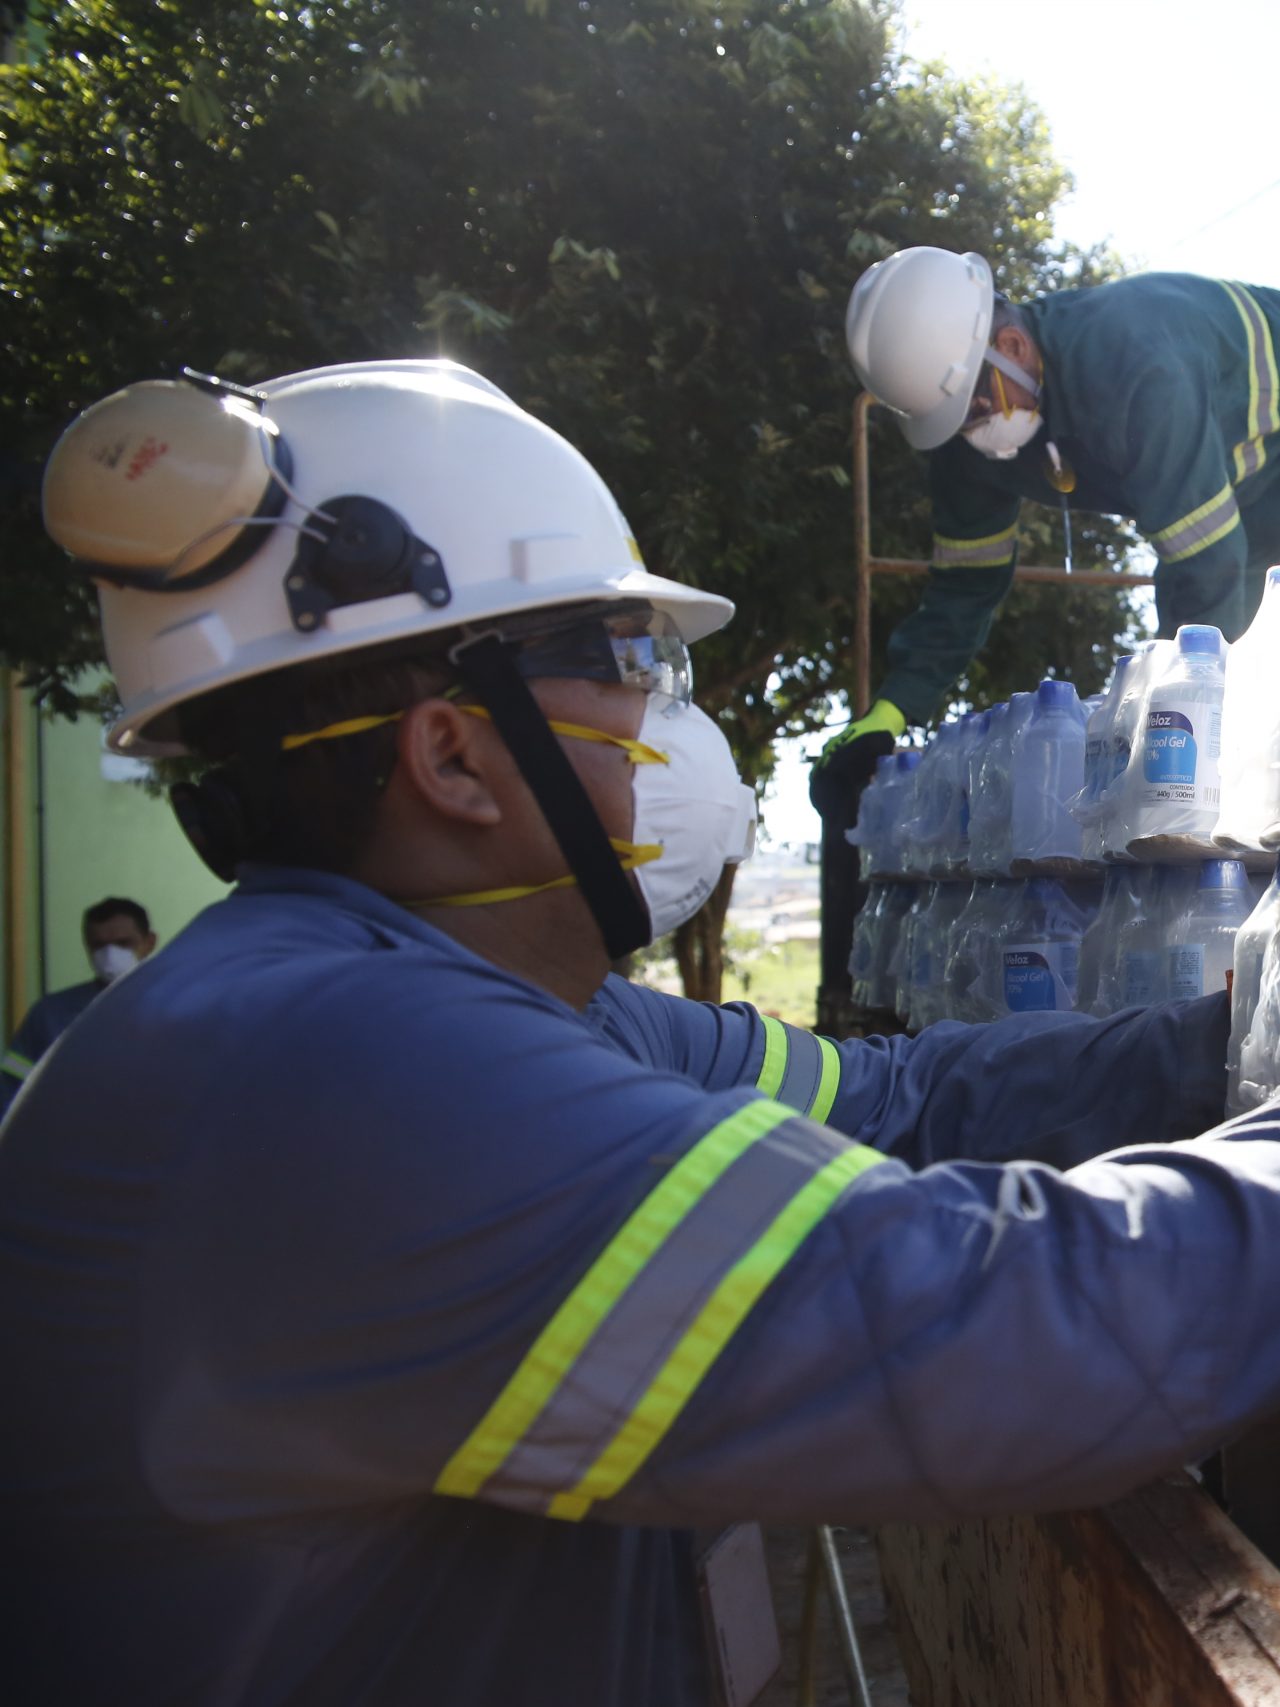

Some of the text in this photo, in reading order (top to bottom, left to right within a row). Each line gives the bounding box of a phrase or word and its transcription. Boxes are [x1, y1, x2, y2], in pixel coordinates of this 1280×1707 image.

[1147, 714, 1171, 726] Veloz
[1169, 736, 1186, 748] Gel
[1175, 791, 1195, 799] 500ml
